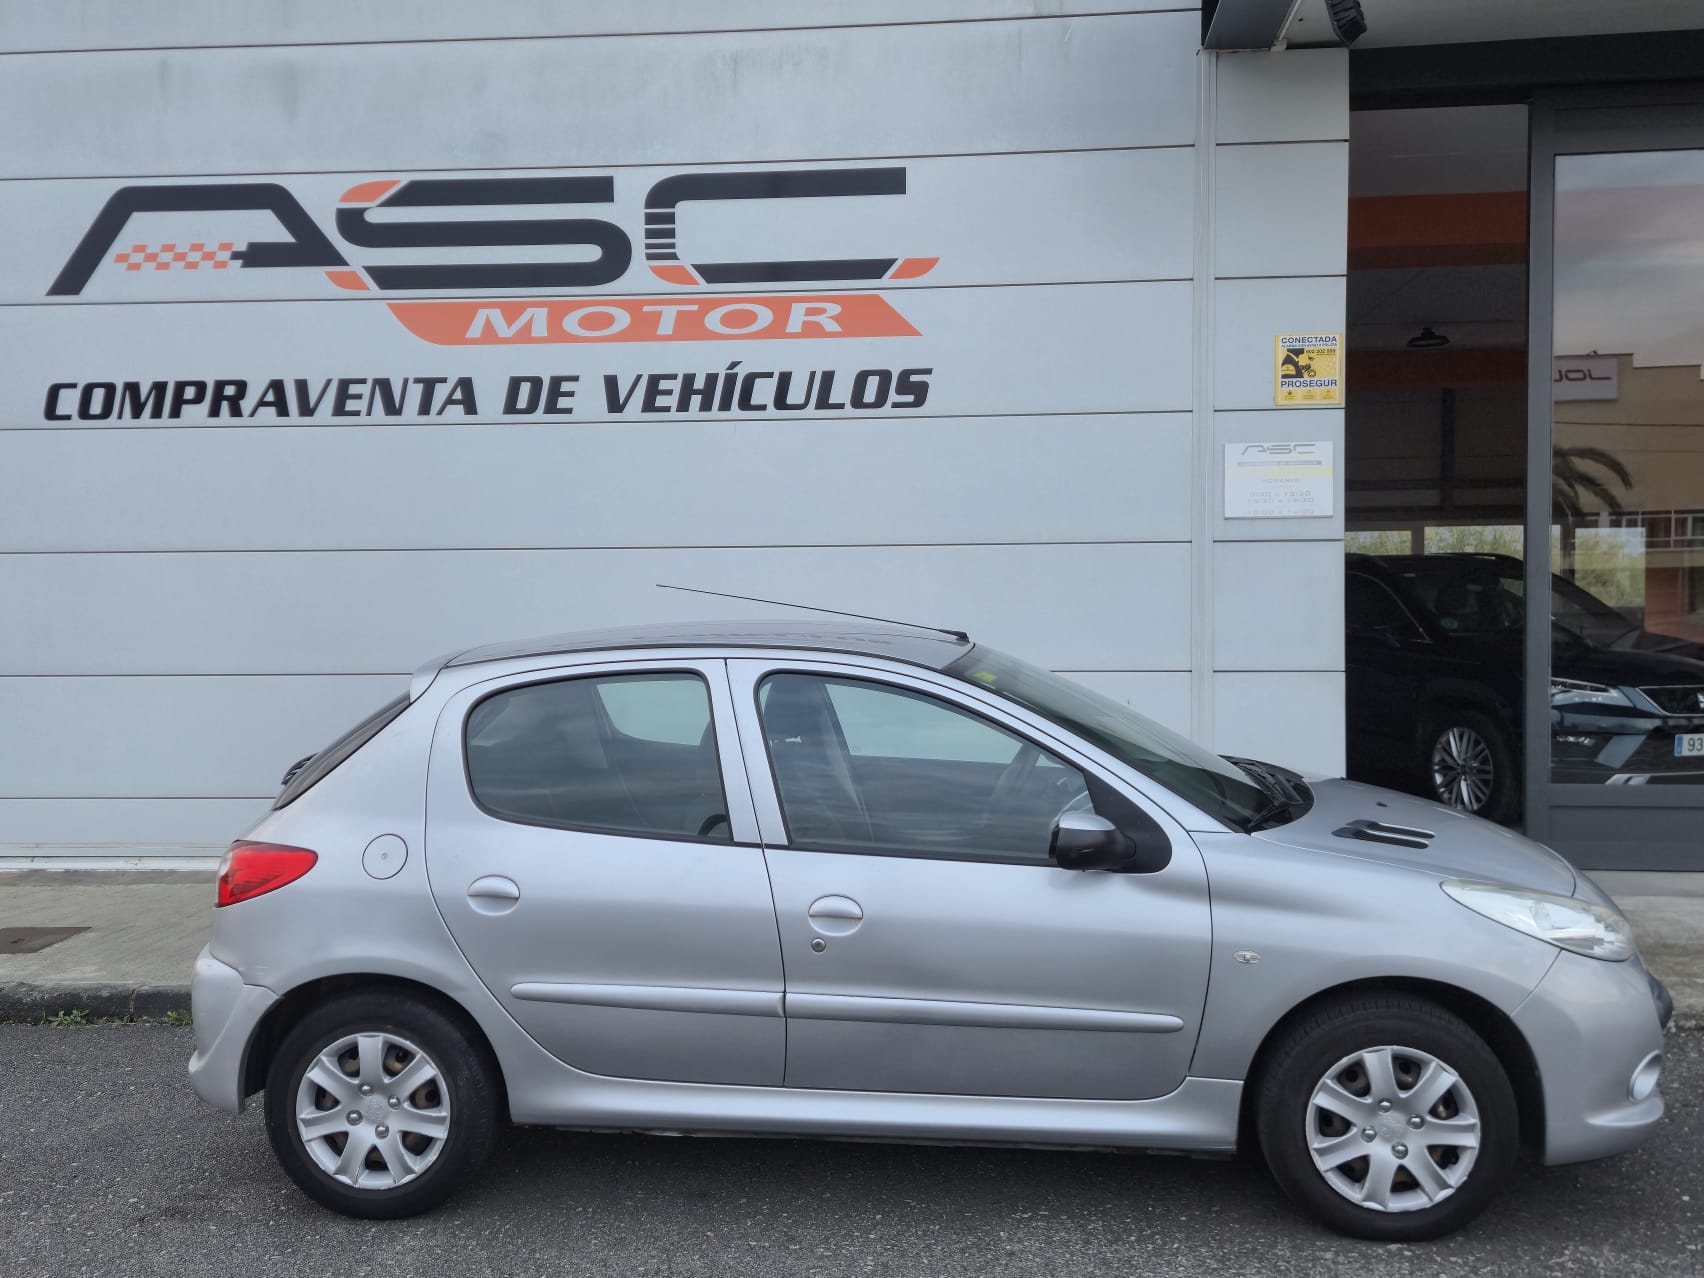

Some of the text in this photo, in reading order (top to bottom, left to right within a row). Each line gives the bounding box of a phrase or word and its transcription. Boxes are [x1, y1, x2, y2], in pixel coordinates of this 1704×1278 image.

[45, 167, 940, 297] ASC
[465, 302, 843, 338] MOTOR
[1281, 335, 1338, 344] CONECTADA
[44, 360, 933, 421] COMPRAVENTA DE VEHÍCULOS
[1280, 379, 1337, 388] PROSEGUR
